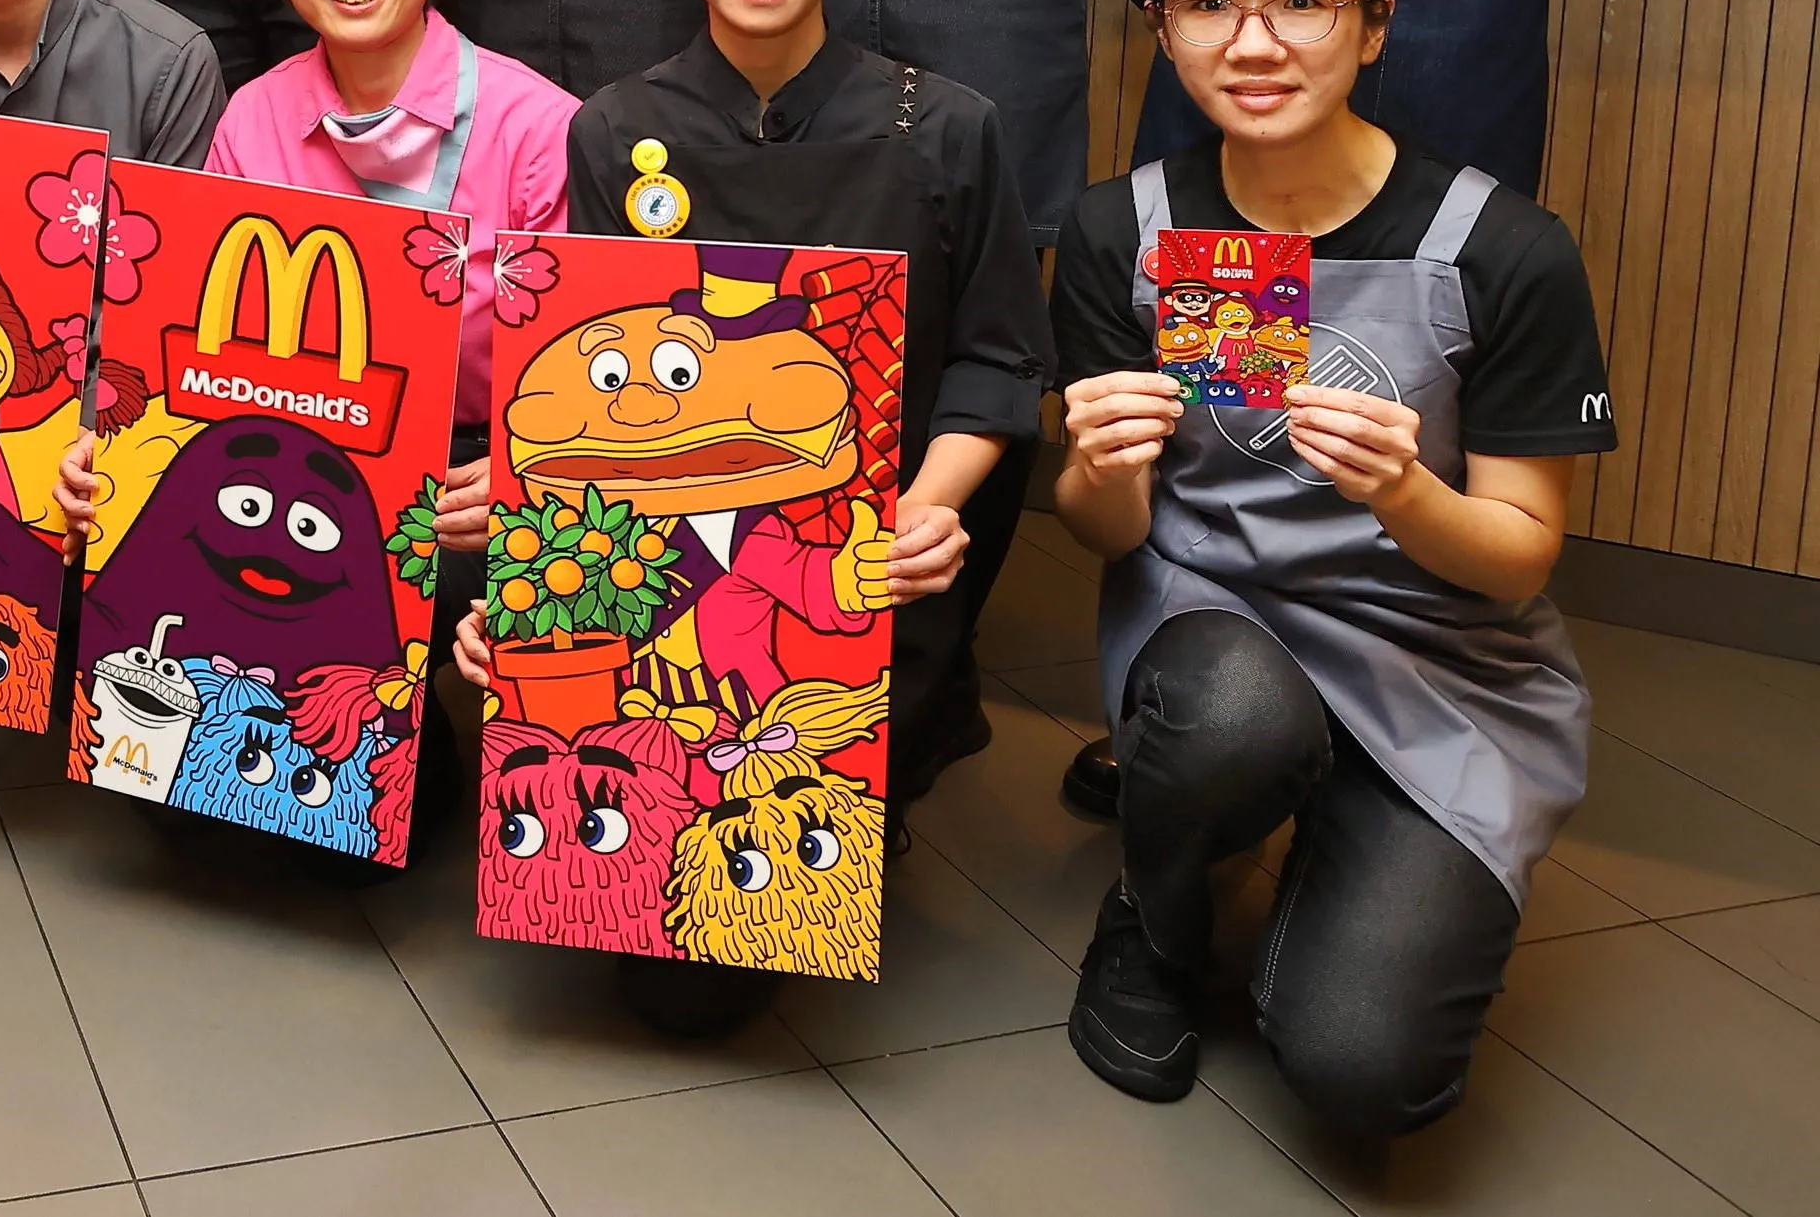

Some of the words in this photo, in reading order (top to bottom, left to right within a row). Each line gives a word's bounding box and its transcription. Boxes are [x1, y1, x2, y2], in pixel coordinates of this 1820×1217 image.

[1212, 267, 1230, 278] 50
[196, 216, 369, 384] M
[180, 367, 370, 427] McDonald's
[112, 756, 158, 782] McDonald's
